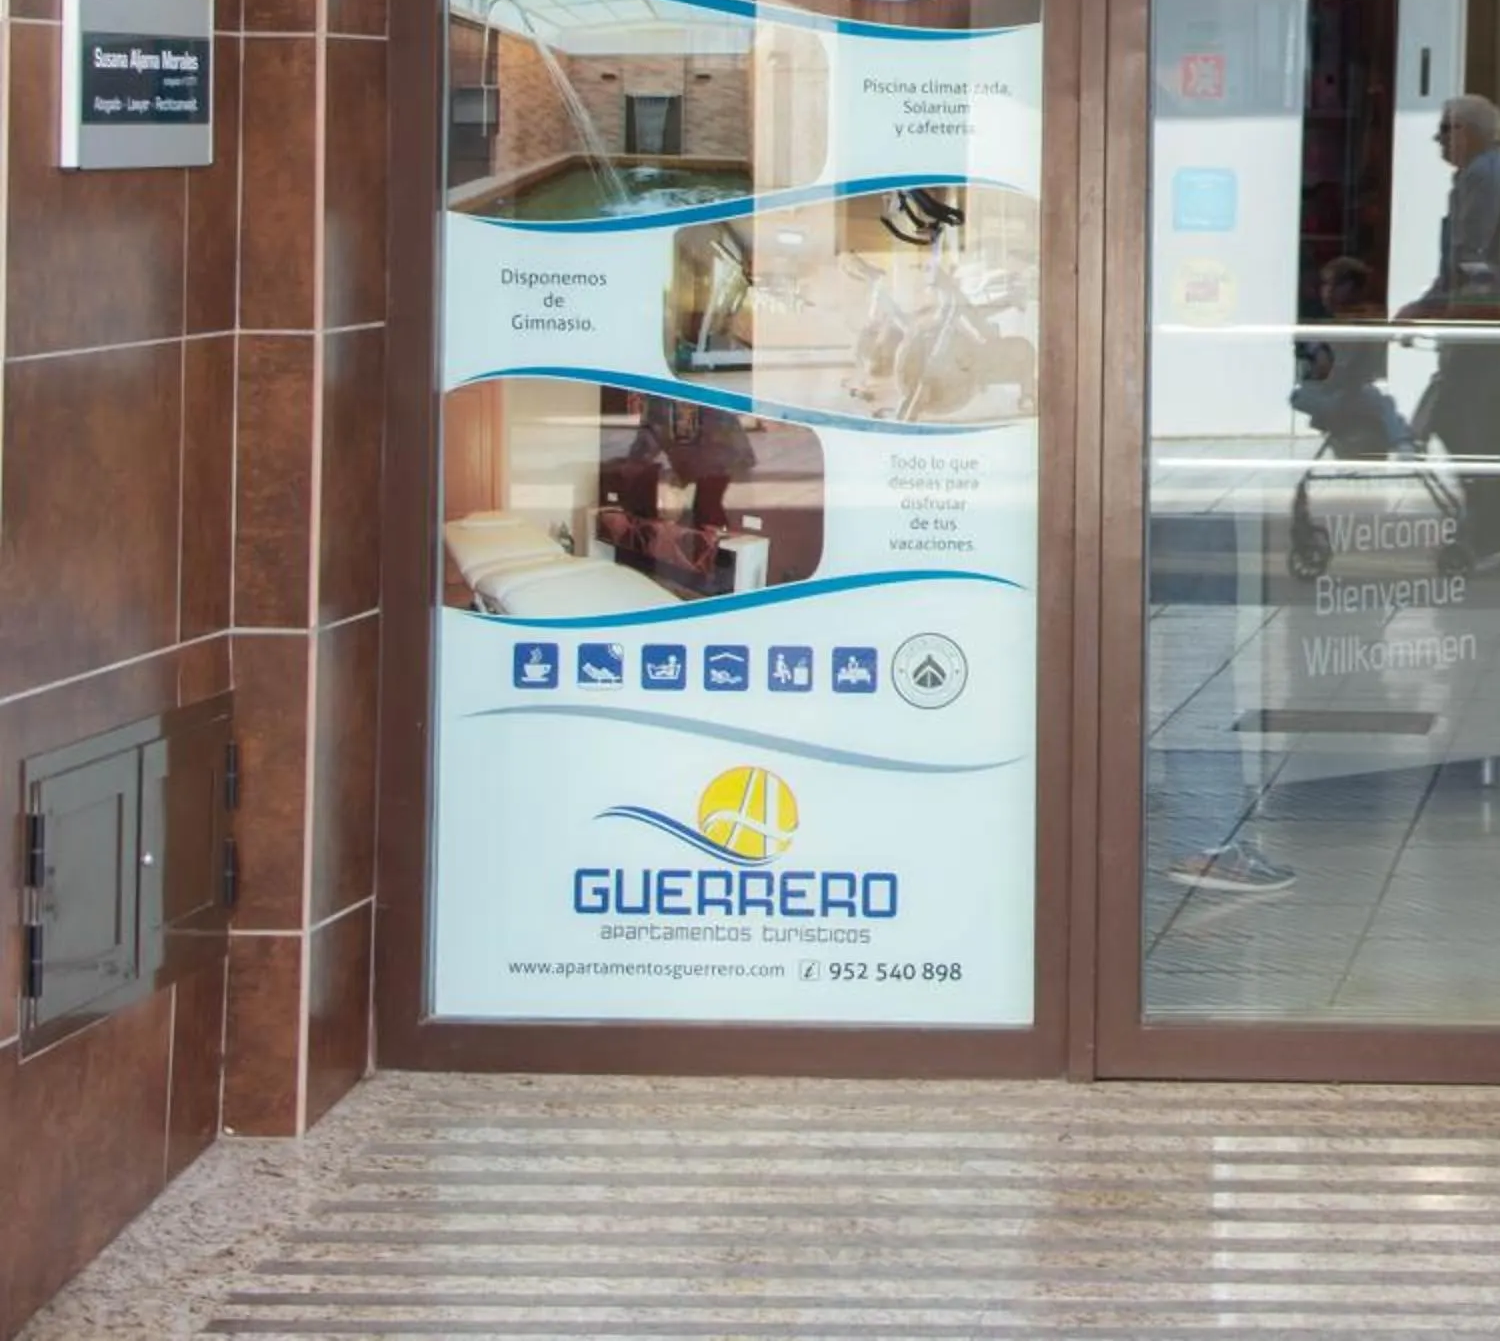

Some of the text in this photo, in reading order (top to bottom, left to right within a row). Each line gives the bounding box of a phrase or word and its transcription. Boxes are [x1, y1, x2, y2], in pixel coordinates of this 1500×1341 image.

[863, 78, 1013, 97] Piscina climatzada,
[903, 99, 971, 115] Solarium
[894, 123, 903, 138] y
[501, 267, 607, 288] Disponemos
[543, 290, 565, 308] de
[511, 313, 597, 332] Gimnasio.
[890, 454, 979, 475] Todo lo que
[888, 475, 979, 493] deseas para
[900, 496, 967, 511] disfrutar
[910, 517, 958, 531] de tus
[1326, 514, 1458, 552] Welcome
[1315, 573, 1466, 616] Bienvenue
[1302, 632, 1477, 677] Willkommen
[574, 867, 898, 919] GUERRERO
[600, 924, 752, 942] apartamentos
[508, 959, 963, 982] www.apartamentosguerrero.com 952 540 898
